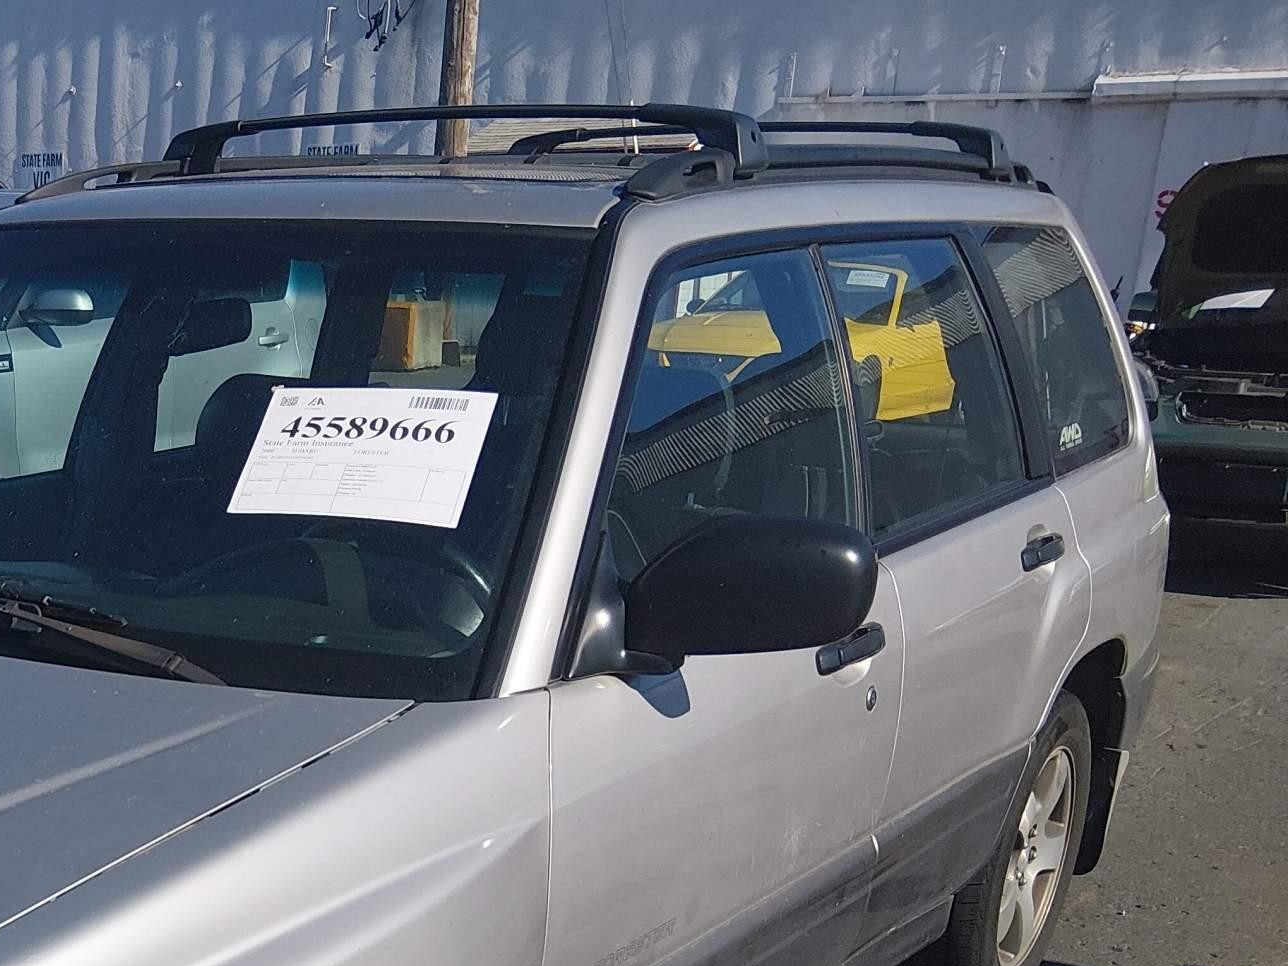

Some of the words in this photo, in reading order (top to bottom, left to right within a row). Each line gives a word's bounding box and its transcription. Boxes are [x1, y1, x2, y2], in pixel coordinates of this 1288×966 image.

[307, 146, 332, 156] STATE
[333, 144, 360, 156] FARM
[21, 153, 42, 168] STATE
[42, 152, 63, 168] FARM
[280, 415, 462, 444] 45589666
[1059, 422, 1083, 446] AWD
[263, 439, 283, 447] State
[286, 439, 311, 448] Farm
[312, 439, 354, 448] Insurance
